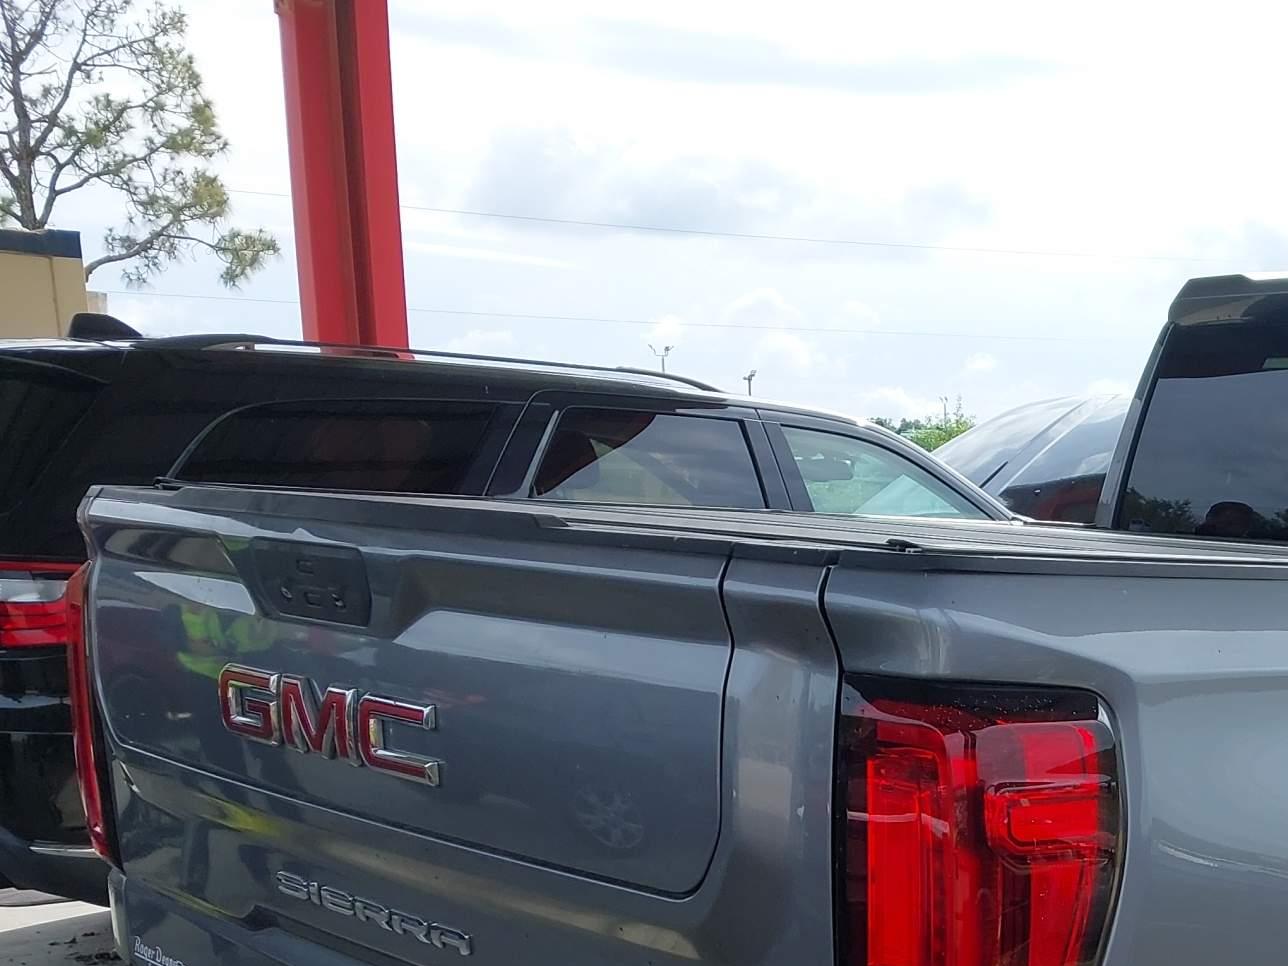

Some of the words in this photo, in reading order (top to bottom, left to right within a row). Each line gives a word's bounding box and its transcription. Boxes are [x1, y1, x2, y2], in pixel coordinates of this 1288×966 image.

[217, 662, 441, 786] GMC
[134, 935, 155, 959] Roger
[275, 870, 472, 956] SIERRA
